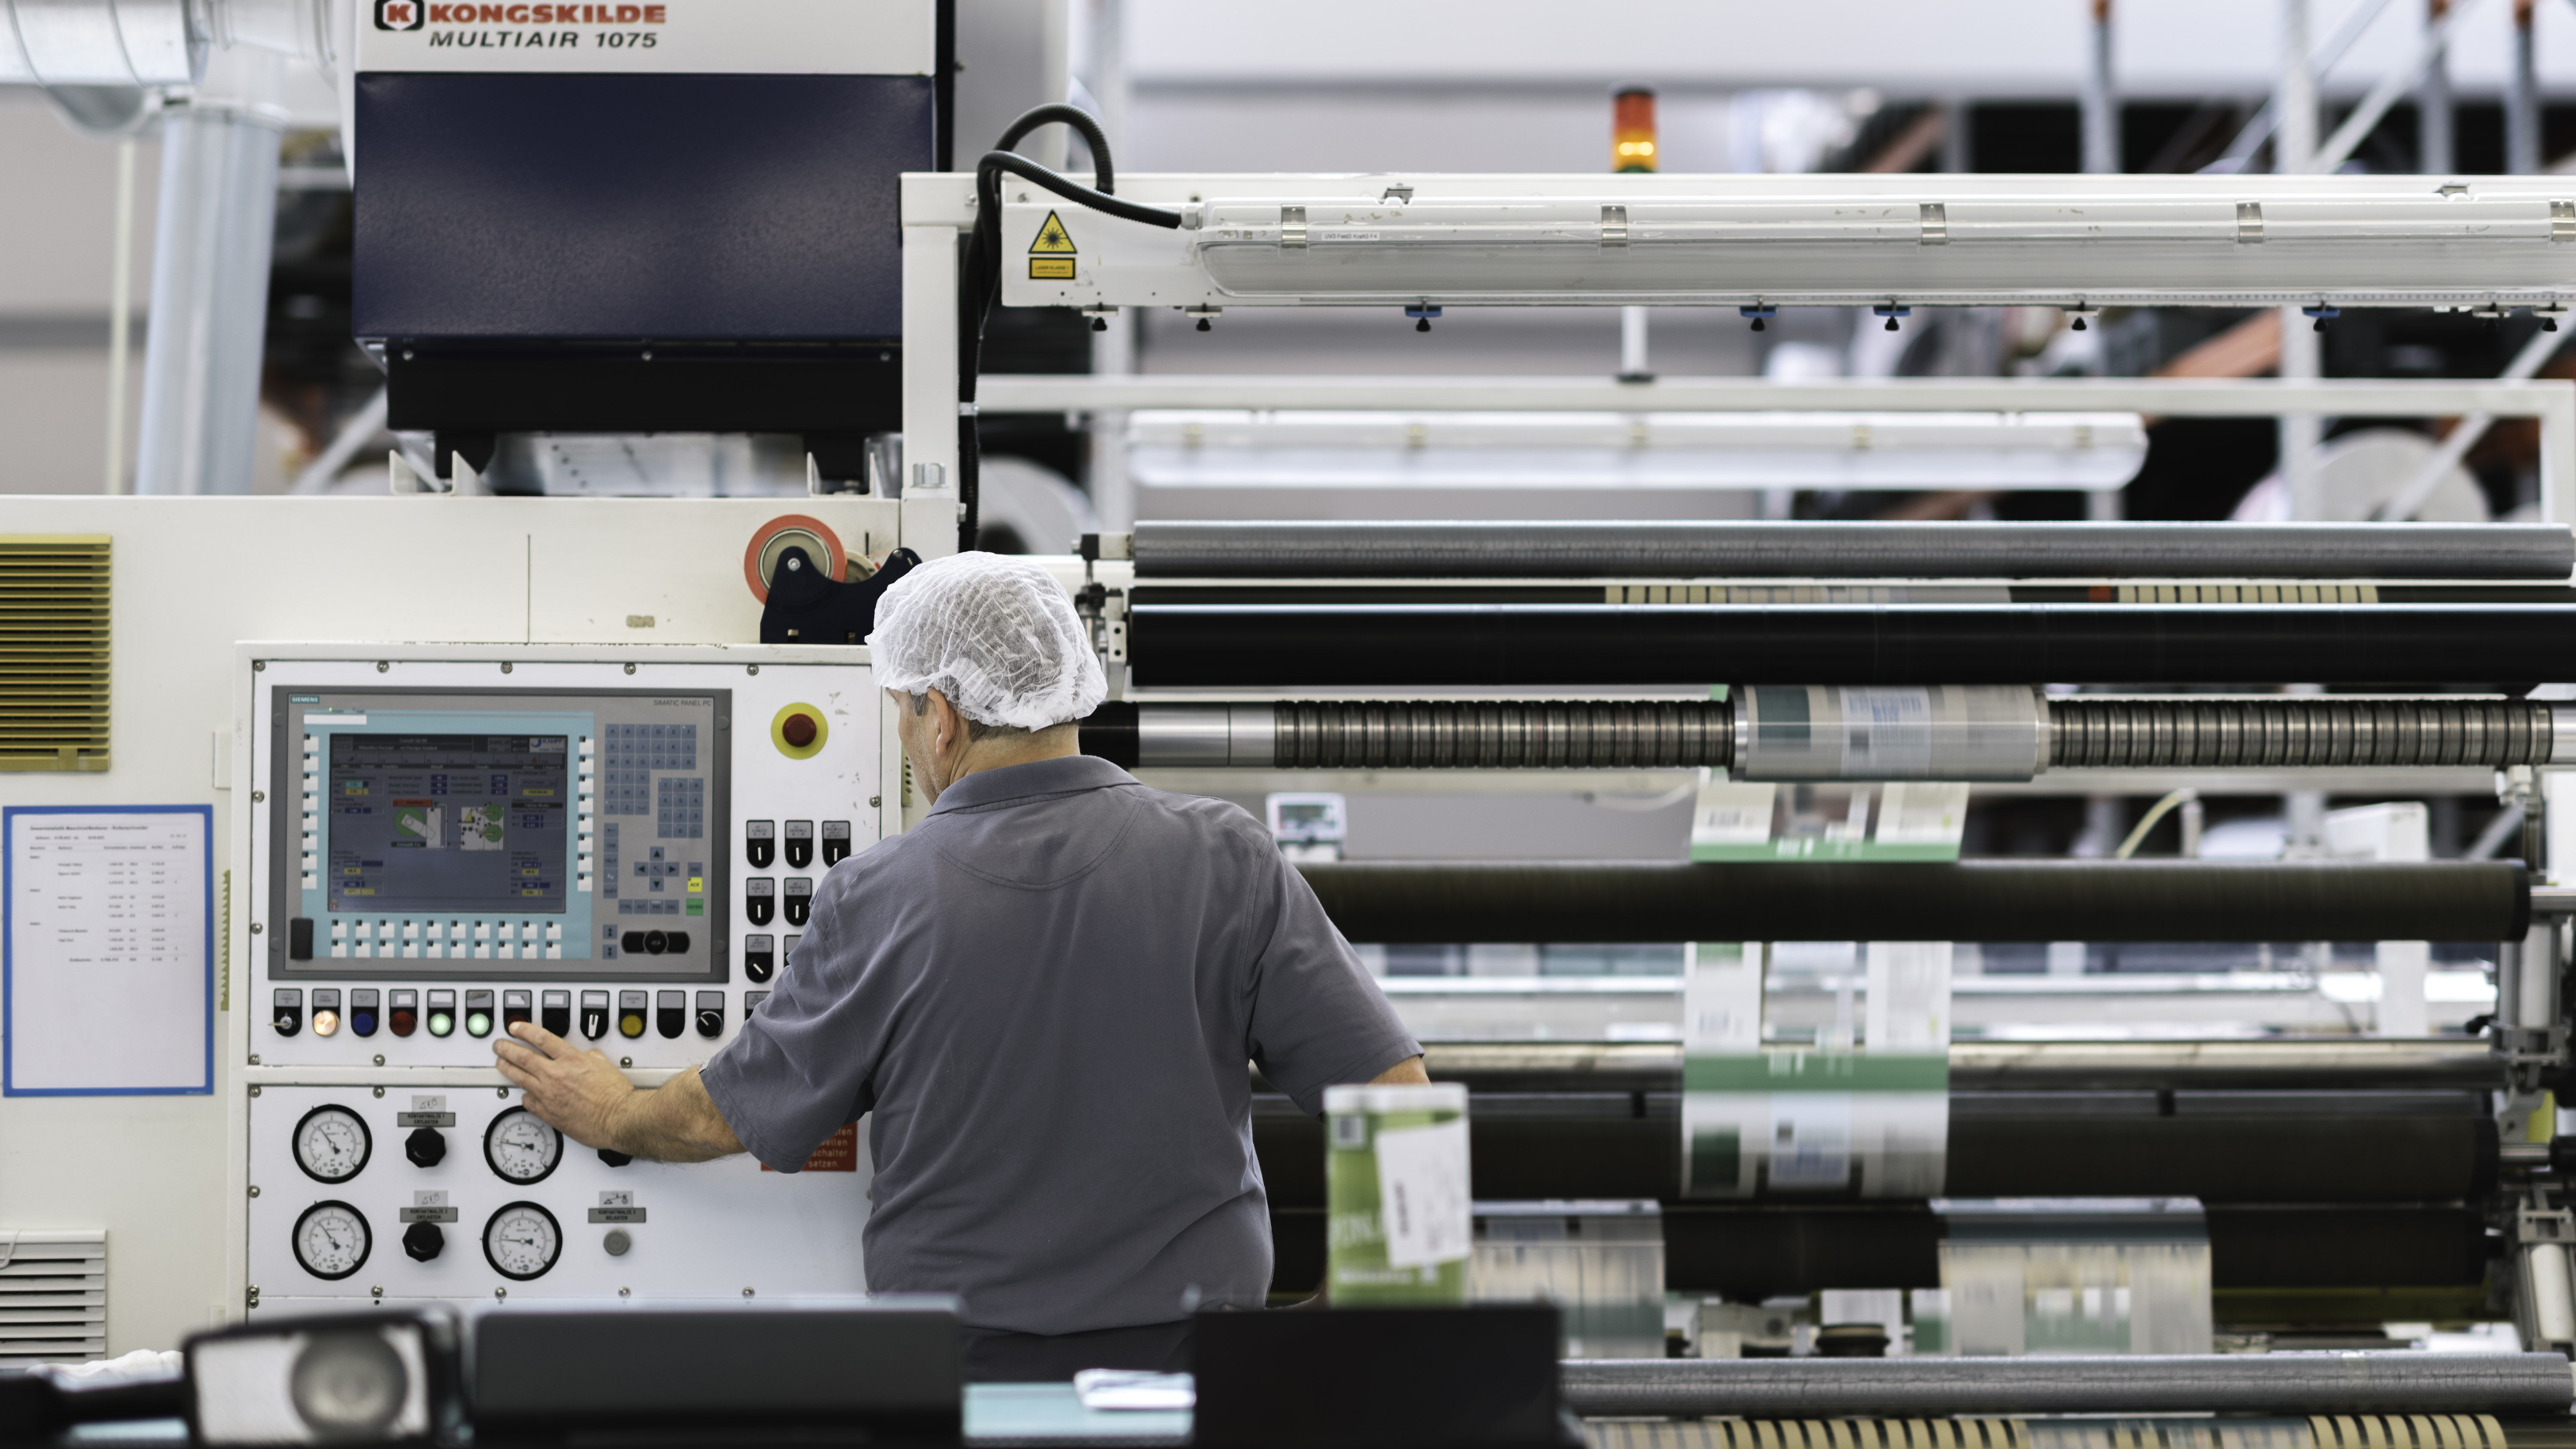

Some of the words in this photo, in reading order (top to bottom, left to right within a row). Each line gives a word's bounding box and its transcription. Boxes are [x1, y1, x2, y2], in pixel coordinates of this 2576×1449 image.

[429, 3, 666, 24] KONGSKILDE
[429, 31, 579, 47] MULTIAIR
[595, 32, 658, 48] 1075
